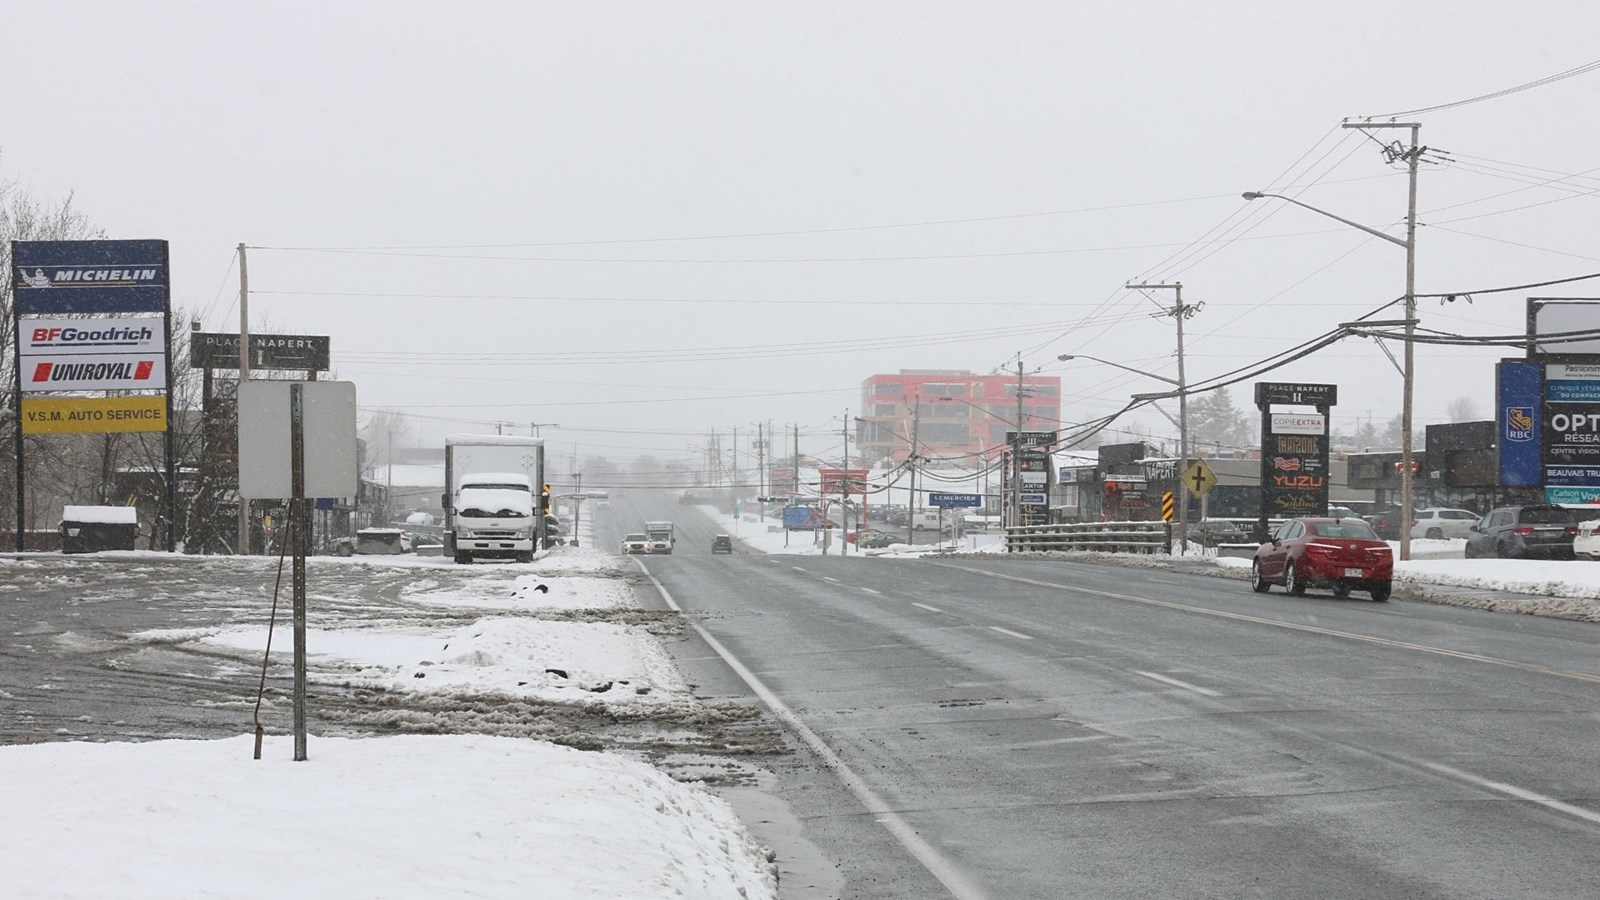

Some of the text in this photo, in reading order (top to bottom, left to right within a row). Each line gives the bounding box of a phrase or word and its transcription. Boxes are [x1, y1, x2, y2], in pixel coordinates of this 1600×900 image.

[54, 270, 156, 281] MICHELIN
[32, 327, 152, 342] BFGoodrich
[206, 338, 313, 348] PLAC NAPERT
[51, 363, 133, 381] UNIROYAL
[28, 409, 161, 421] V.S.M. AUTO SERVICE
[1509, 431, 1530, 439] RBC
[1274, 476, 1322, 486] YUZU
[1580, 492, 1600, 502] Voy
